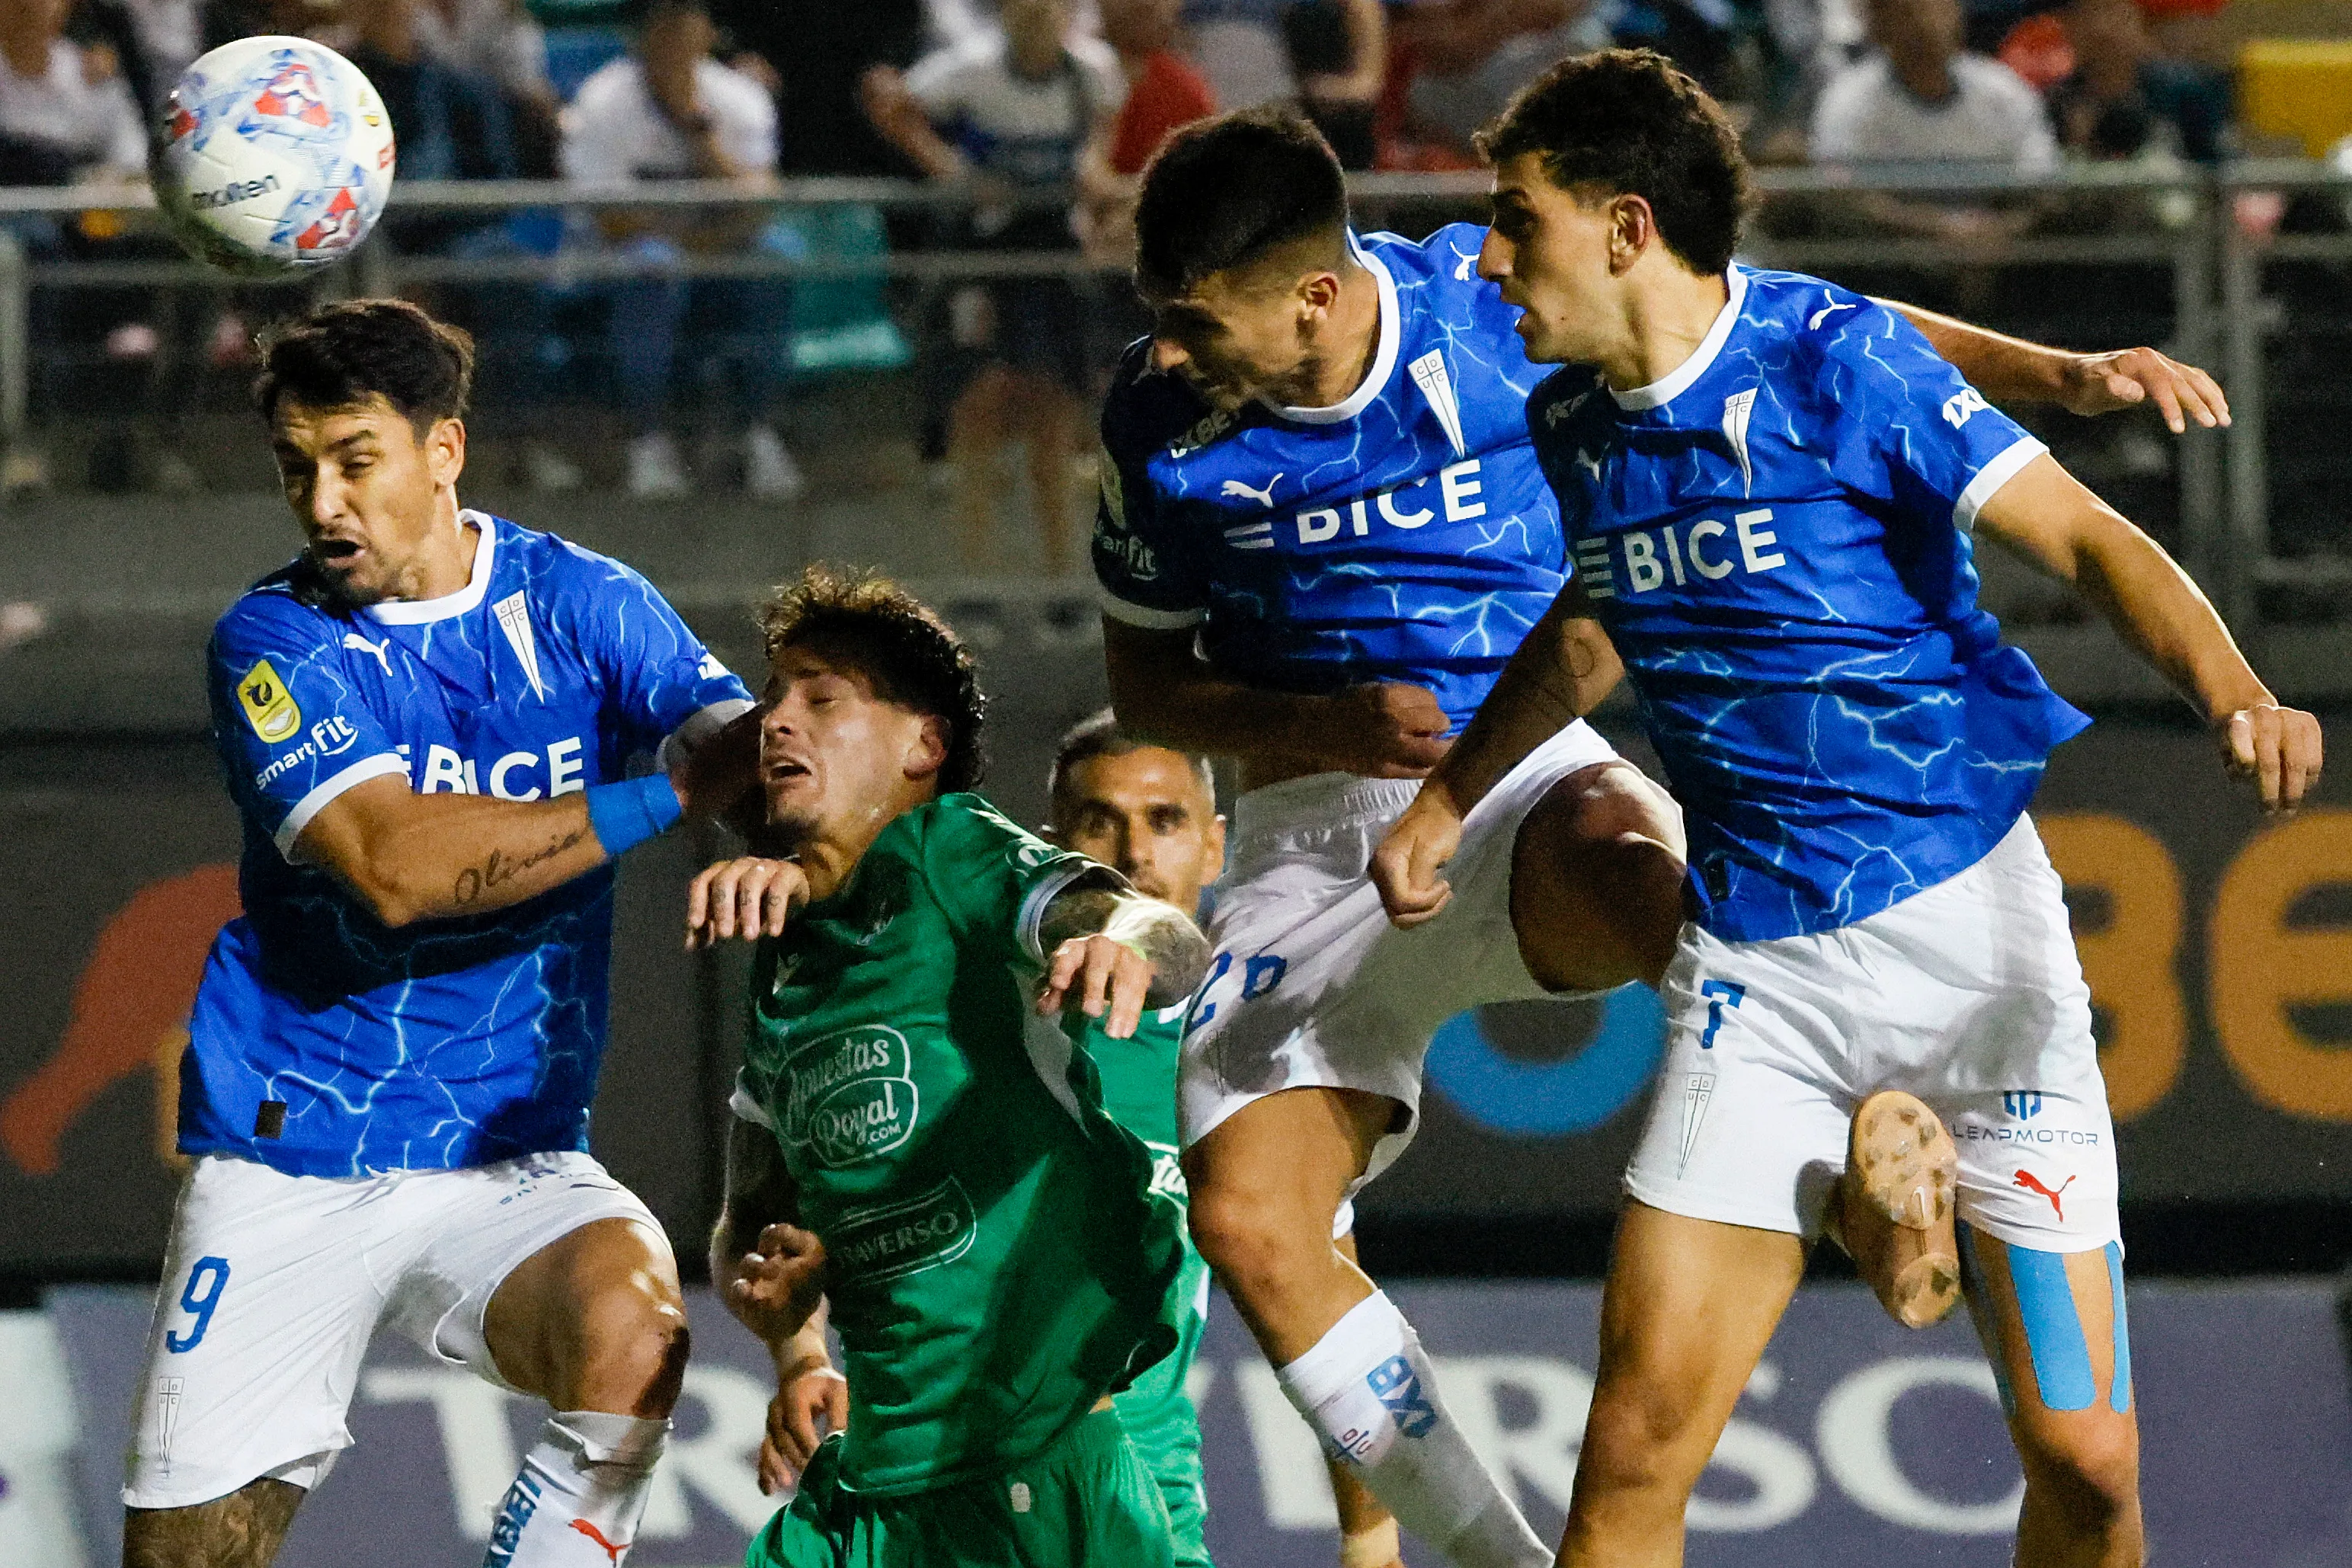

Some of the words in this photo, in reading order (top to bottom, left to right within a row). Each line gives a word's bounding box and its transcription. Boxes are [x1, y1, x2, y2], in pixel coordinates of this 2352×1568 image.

[1296, 459, 1486, 545] BICE
[1624, 508, 1786, 594] BICE
[422, 736, 585, 802] BICE
[1700, 979, 1746, 1050] 7
[814, 1081, 900, 1159] Royal
[1953, 1123, 2098, 1147] LEAPMOTOR
[166, 1256, 231, 1355] 9
